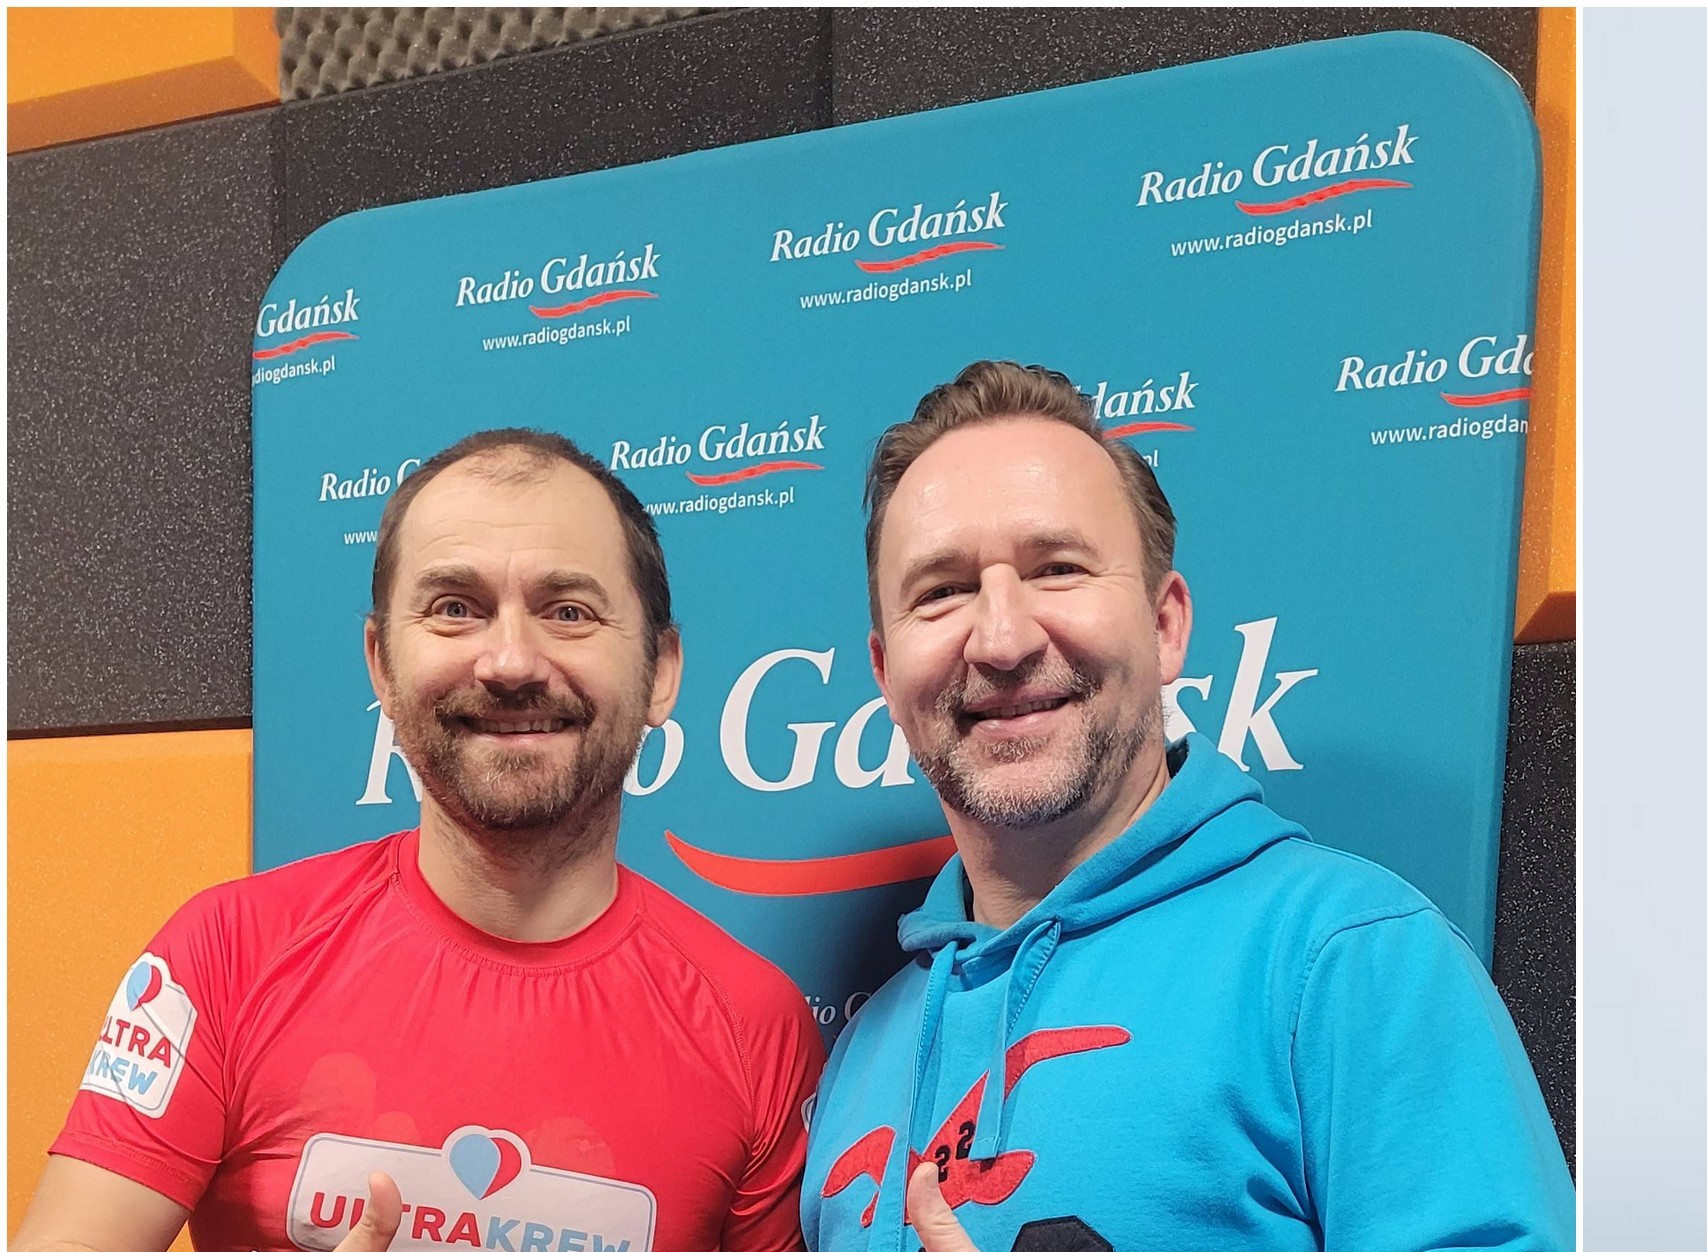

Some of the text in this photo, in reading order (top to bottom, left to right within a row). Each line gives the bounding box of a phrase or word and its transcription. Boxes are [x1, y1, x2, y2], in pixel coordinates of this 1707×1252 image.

[1136, 124, 1419, 207] Radio Gdańsk
[770, 191, 1008, 262] Radio Gdańsk
[1171, 209, 1372, 256] www.radiogdansk.pl
[455, 243, 661, 307] Radio Gdańsk
[800, 269, 972, 308] www.radiogdansk.pl
[256, 288, 361, 337] Gdańsk
[482, 315, 631, 350] www.radiogdansk.pl
[1076, 371, 1199, 419] dańsk
[1334, 349, 1448, 393] Radio
[610, 415, 828, 471] Radio Gdańsk
[318, 468, 391, 502] Radio
[99, 1015, 172, 1069] LTRA
